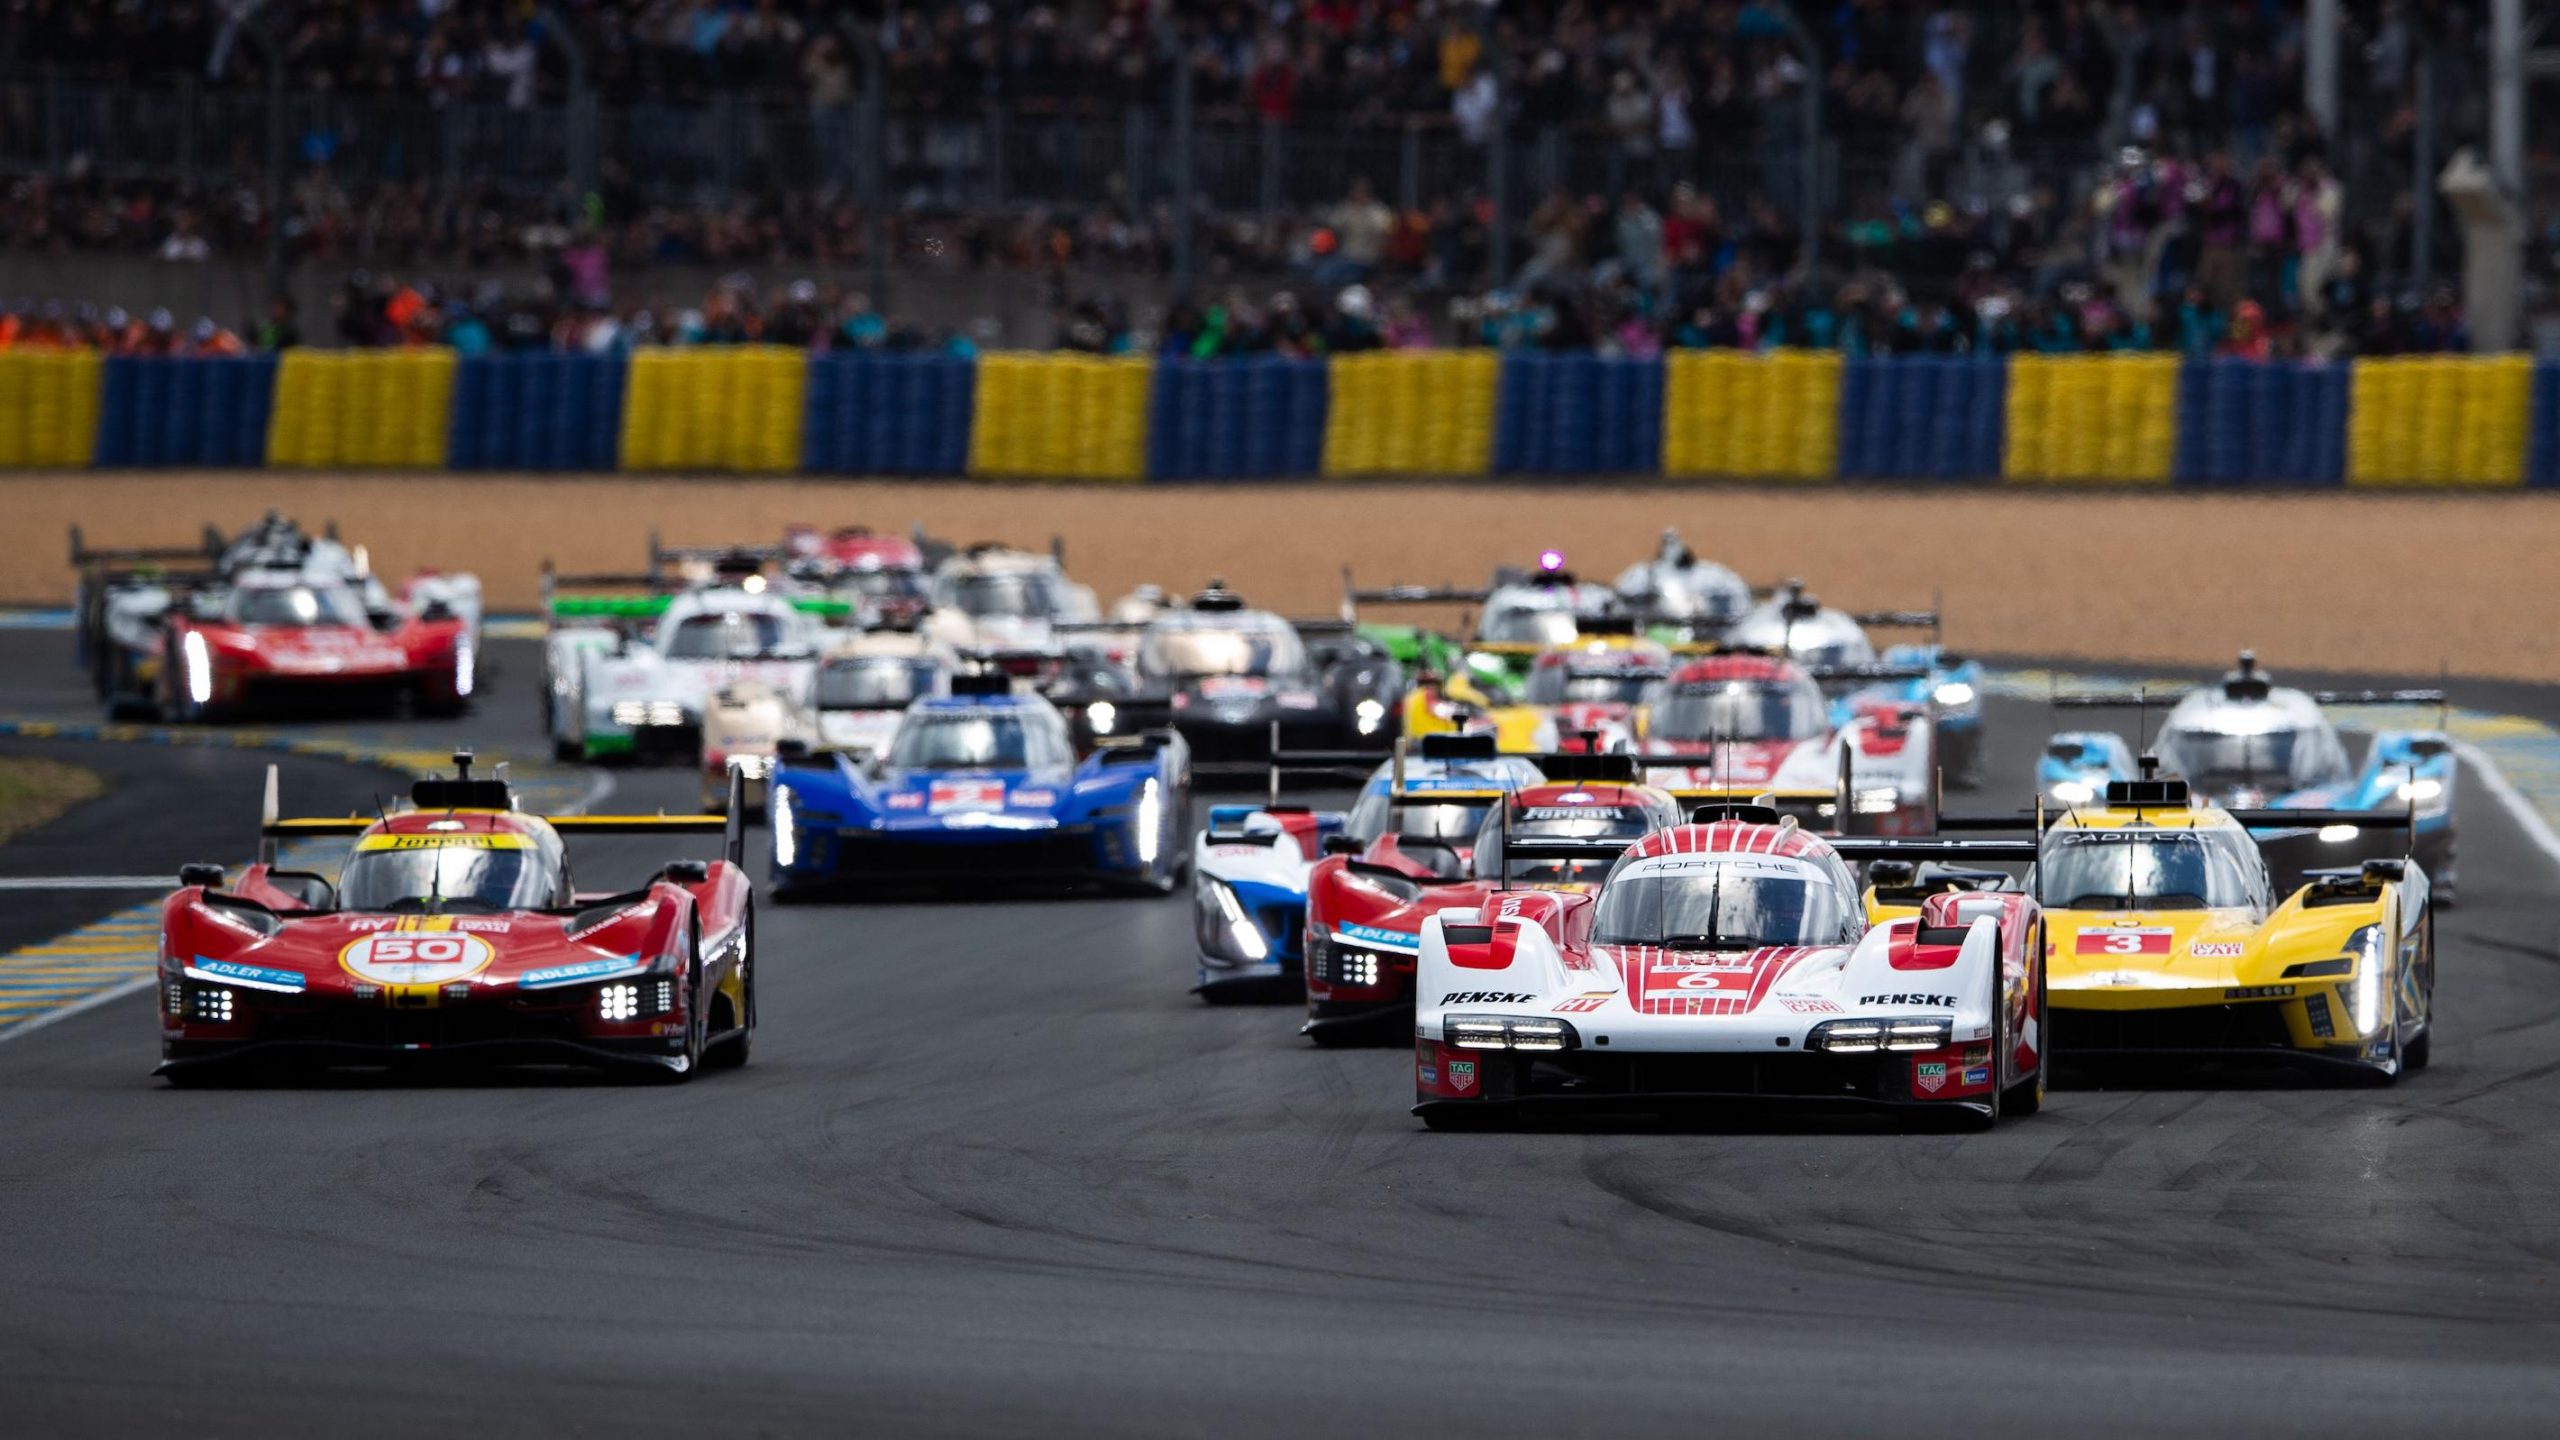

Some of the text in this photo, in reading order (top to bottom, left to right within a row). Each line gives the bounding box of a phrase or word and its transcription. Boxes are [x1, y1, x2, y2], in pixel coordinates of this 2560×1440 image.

[1523, 807, 1624, 820] Ferrari
[392, 836, 494, 848] Ferrari
[2063, 833, 2213, 845] CADILLAC
[1643, 861, 1799, 874] PORSCHE
[1347, 927, 1405, 943] ADLER
[374, 940, 461, 961] 50
[2104, 935, 2142, 953] 3
[201, 962, 263, 978] ADLER
[527, 965, 589, 982] ADLER
[1677, 972, 1720, 989] 6
[1439, 992, 1538, 1007] PENSKE
[1553, 998, 1608, 1012] HY
[1860, 993, 1958, 1008] PENSKE
[1790, 1003, 1840, 1013] CAR
[1451, 1062, 1472, 1073] TAG
[1920, 1064, 1944, 1075] TAG
[1449, 1074, 1474, 1088] HEUER
[1919, 1076, 1946, 1090] HEUER
